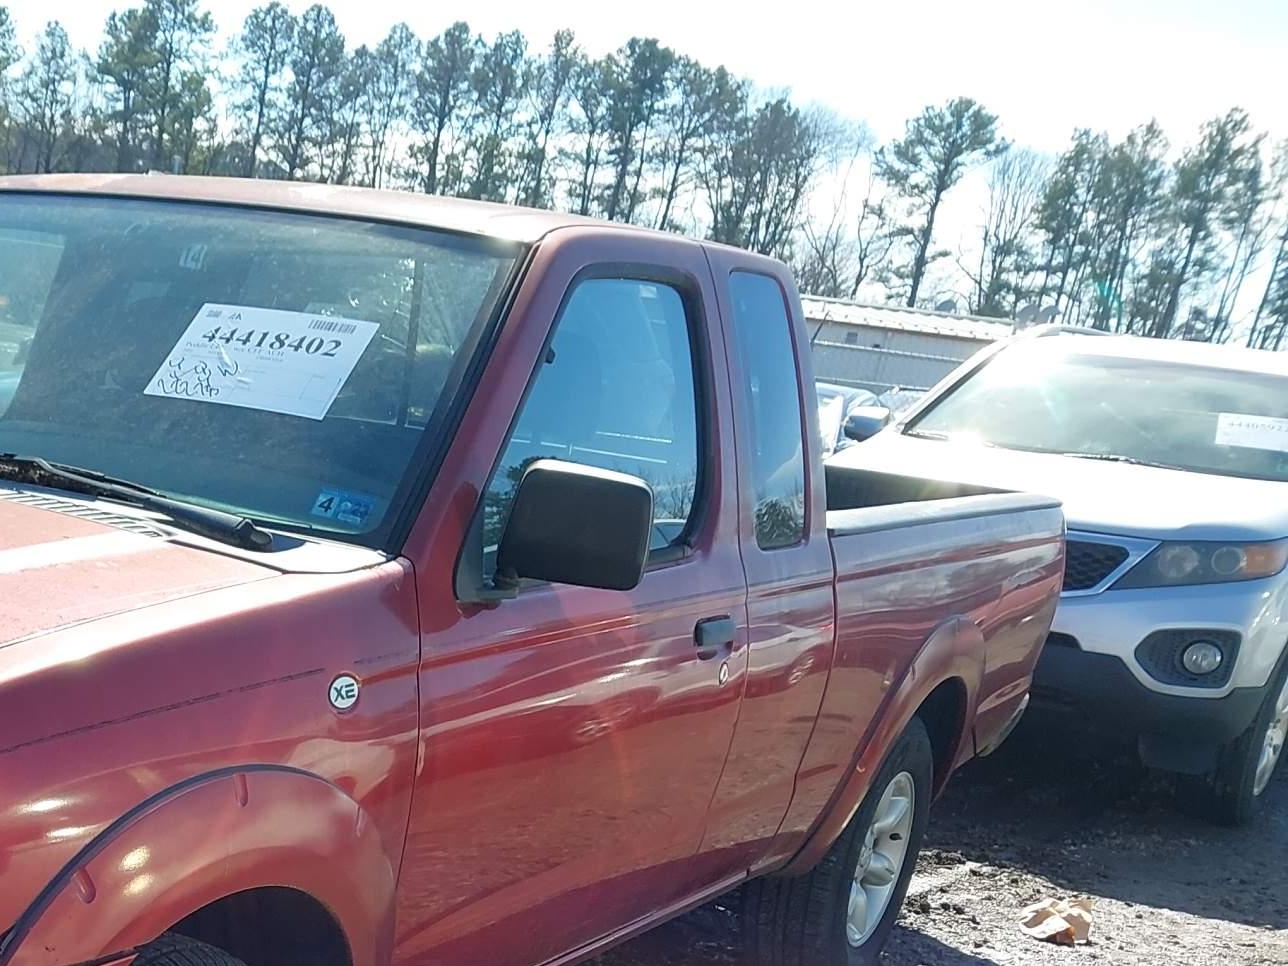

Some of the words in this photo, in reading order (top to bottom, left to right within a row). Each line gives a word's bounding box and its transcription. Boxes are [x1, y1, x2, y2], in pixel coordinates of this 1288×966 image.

[202, 326, 342, 357] 44418402
[318, 496, 334, 512] 4
[333, 682, 356, 703] XE
